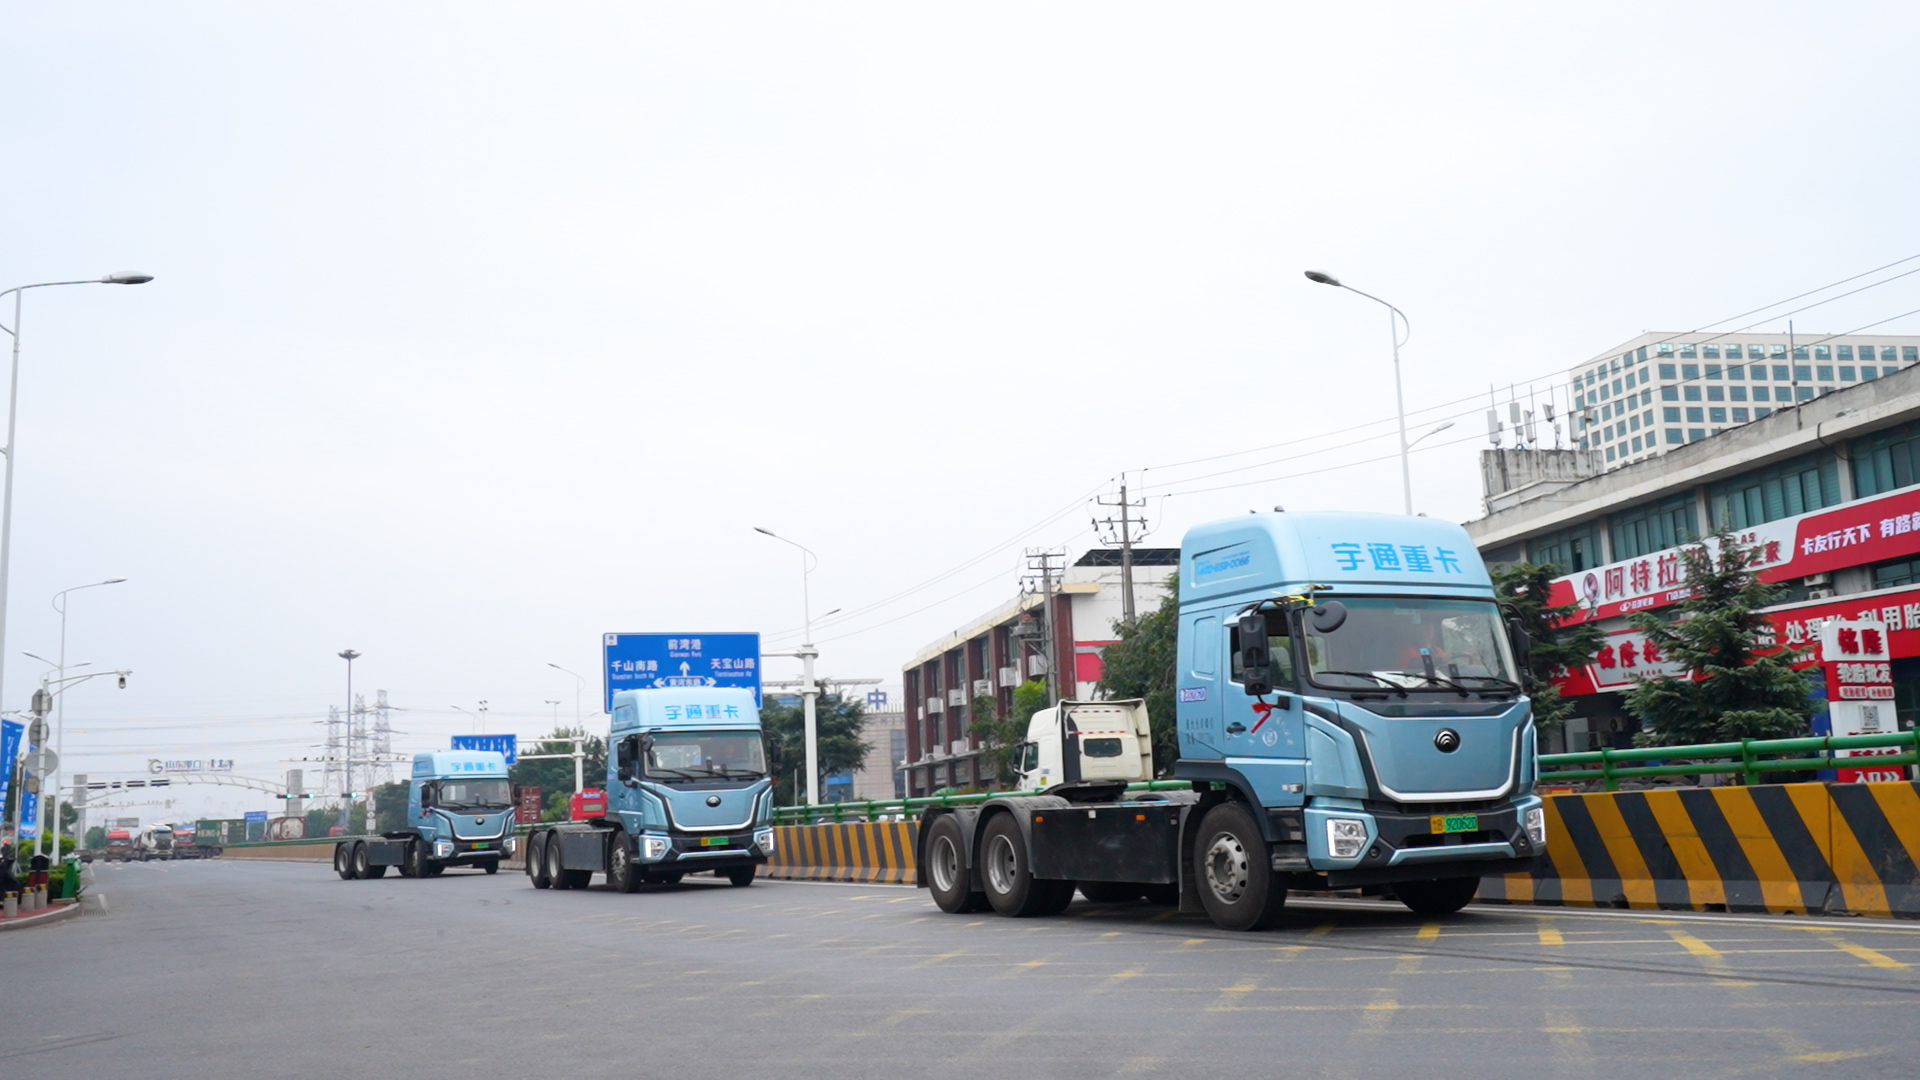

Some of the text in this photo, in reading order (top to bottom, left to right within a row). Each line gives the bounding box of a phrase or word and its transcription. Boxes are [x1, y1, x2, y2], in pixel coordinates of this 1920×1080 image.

[1801, 523, 1871, 556] 卡友行天下
[1331, 542, 1462, 574] 宇通重卡
[668, 639, 702, 650] 前湾港
[611, 660, 658, 672] 千山南路
[711, 658, 756, 669] 天宝山路
[867, 688, 887, 710] 中
[665, 704, 739, 720] 宇通重卡
